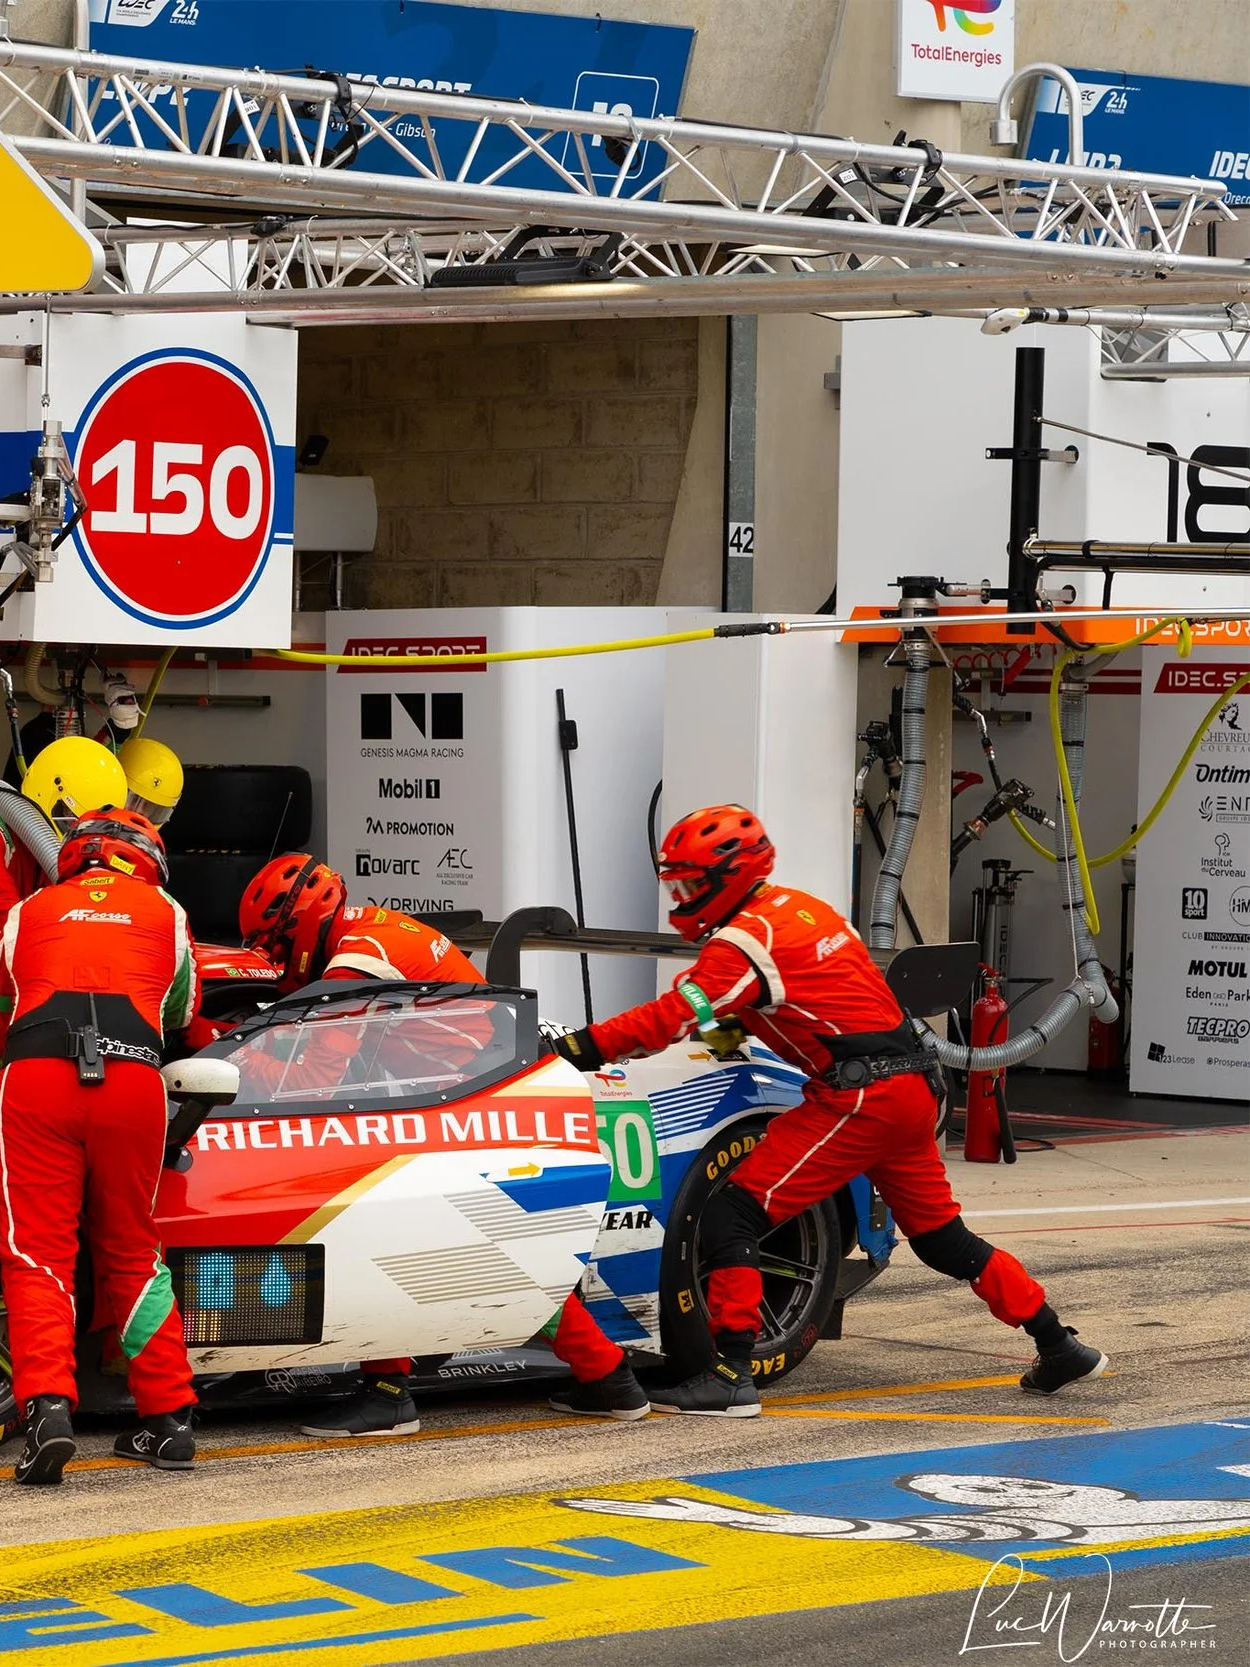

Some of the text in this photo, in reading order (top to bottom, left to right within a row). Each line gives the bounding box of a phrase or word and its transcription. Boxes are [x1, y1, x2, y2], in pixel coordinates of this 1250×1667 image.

[911, 44, 1002, 67] TotalEnergies
[1106, 91, 1128, 109] 24h
[395, 122, 436, 138] Gibson
[1209, 150, 1250, 181] IDE
[90, 439, 263, 540] 150
[729, 526, 754, 555] 42
[1168, 671, 1250, 687] IDEC.S
[360, 748, 464, 758] GENESIS MAGMA RACING
[379, 778, 422, 799] Mobil
[387, 822, 454, 836] PROMOTION
[356, 854, 420, 876] novarc
[1201, 857, 1233, 868] Institut
[1209, 867, 1246, 878] Cerveau
[390, 898, 454, 912] DRIVING
[1185, 890, 1205, 909] 10
[1184, 908, 1205, 918] sport
[1182, 931, 1203, 940] CLUB
[248, 968, 277, 979] TOLEDO
[1188, 960, 1248, 978] MOTUL
[1186, 987, 1250, 1002] Eden Park
[1187, 1016, 1250, 1038] TECPRO
[195, 1110, 592, 1151] RICHARD MILLE
[706, 1135, 756, 1180] GOOD
[438, 1359, 527, 1379] BRINKLEY
[295, 1375, 332, 1388] RIBEIRO
